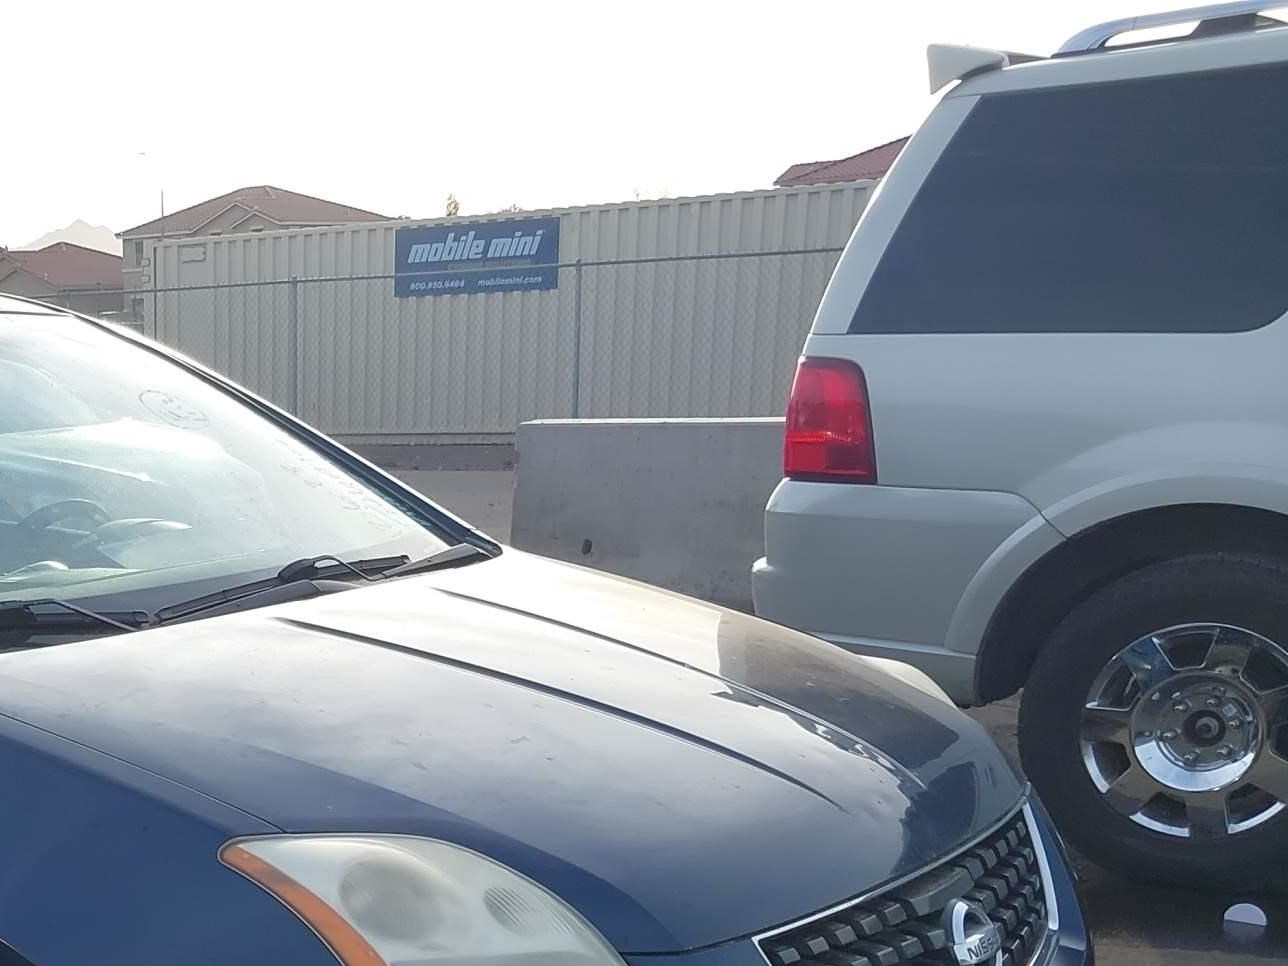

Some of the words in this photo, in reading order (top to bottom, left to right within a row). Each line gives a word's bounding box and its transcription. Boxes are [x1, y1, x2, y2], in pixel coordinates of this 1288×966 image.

[408, 230, 482, 263] mobile
[487, 230, 543, 258] mini
[477, 275, 542, 287] mobilemini.com
